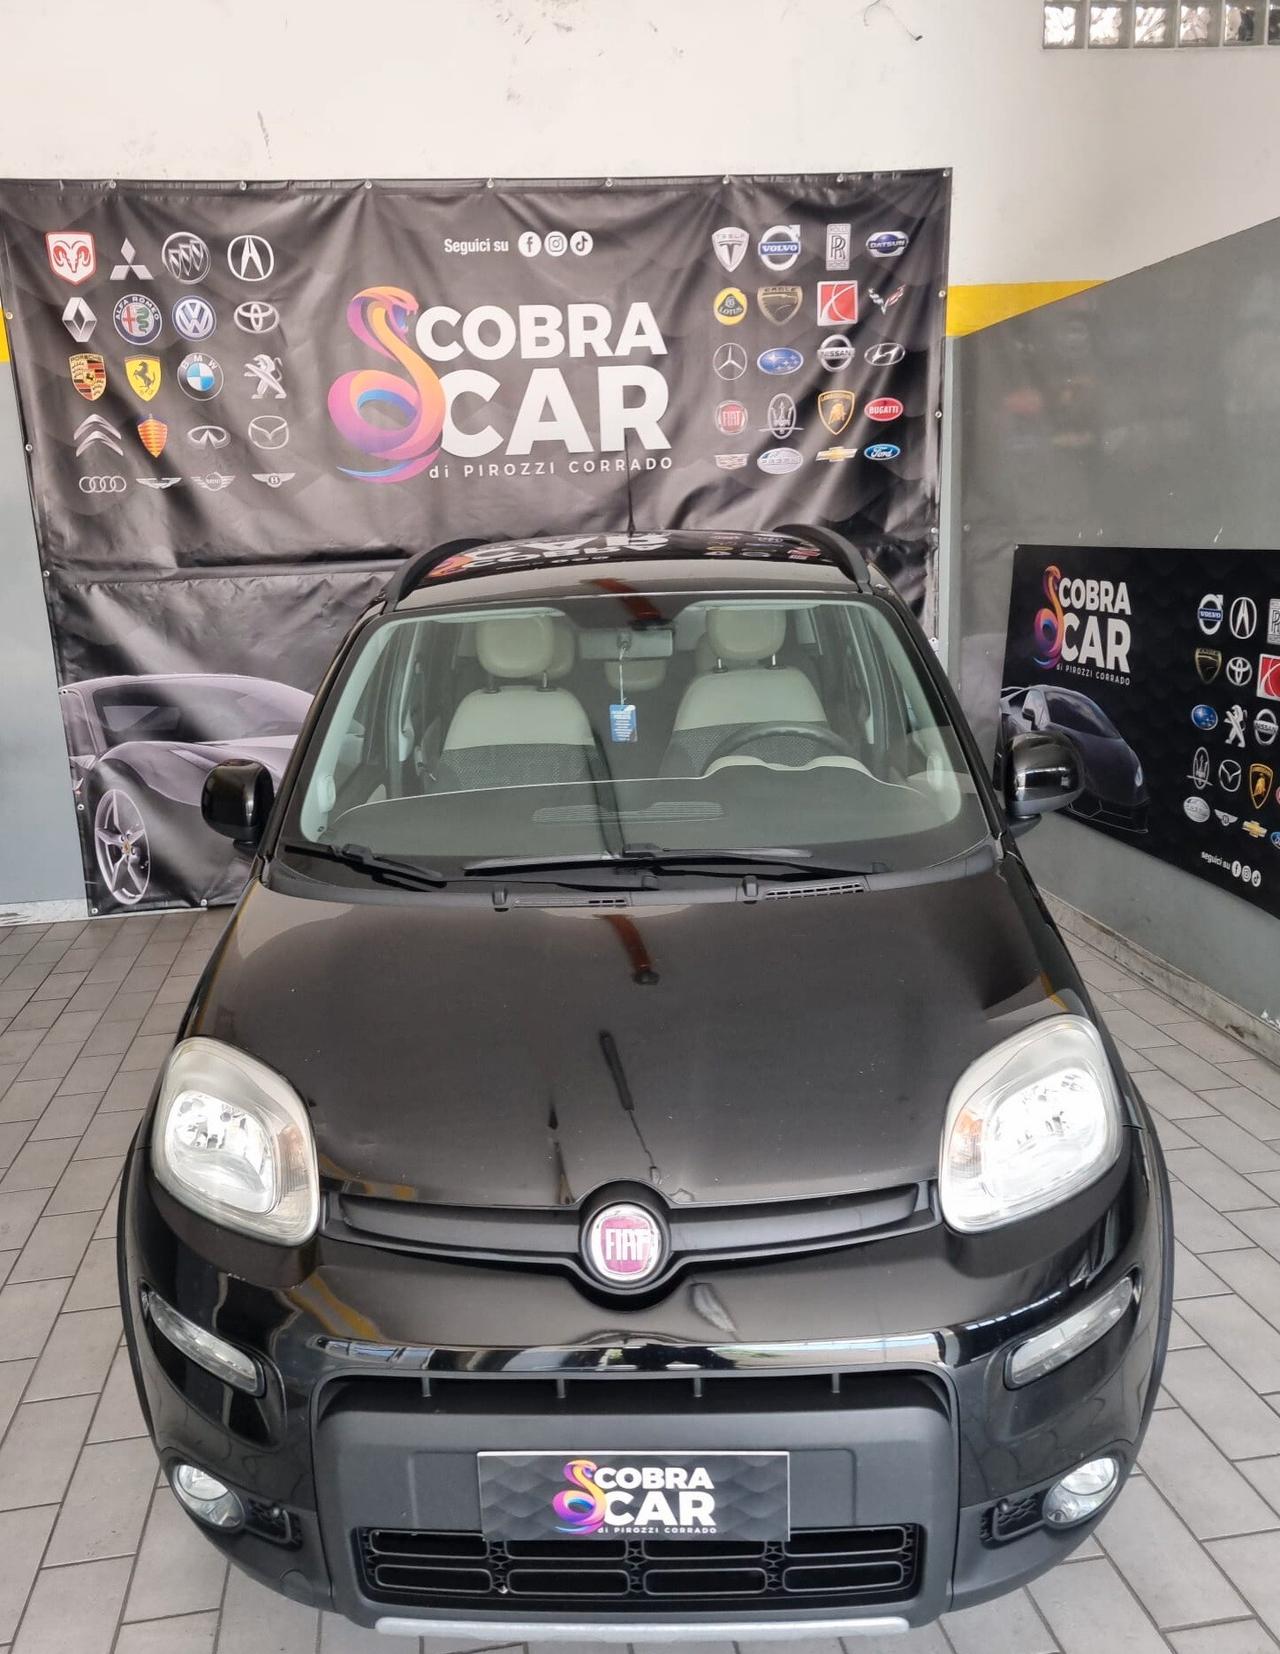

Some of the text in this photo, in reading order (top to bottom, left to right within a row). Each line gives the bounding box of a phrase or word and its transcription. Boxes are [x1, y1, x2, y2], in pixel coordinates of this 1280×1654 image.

[443, 237, 509, 256] Seguici su
[762, 244, 798, 253] VOLVO
[869, 240, 906, 249] DATSUN
[115, 296, 160, 321] ALFA ROMEO
[415, 301, 668, 362] COBRA
[438, 364, 672, 458] CAR
[868, 405, 899, 415] BUGATTI
[429, 456, 673, 479] di PIROZZI CORRADO
[1058, 577, 1132, 615] COBRA
[1200, 609, 1221, 619] VOLVO
[1061, 612, 1131, 673] CAR
[1056, 663, 1131, 686] di PIROZZI CORRADO
[605, 1228, 650, 1261] FIAT
[593, 1466, 715, 1490] COBRA
[604, 1490, 717, 1526] CAR
[597, 1526, 718, 1534] di PIROZZI CORRADO
